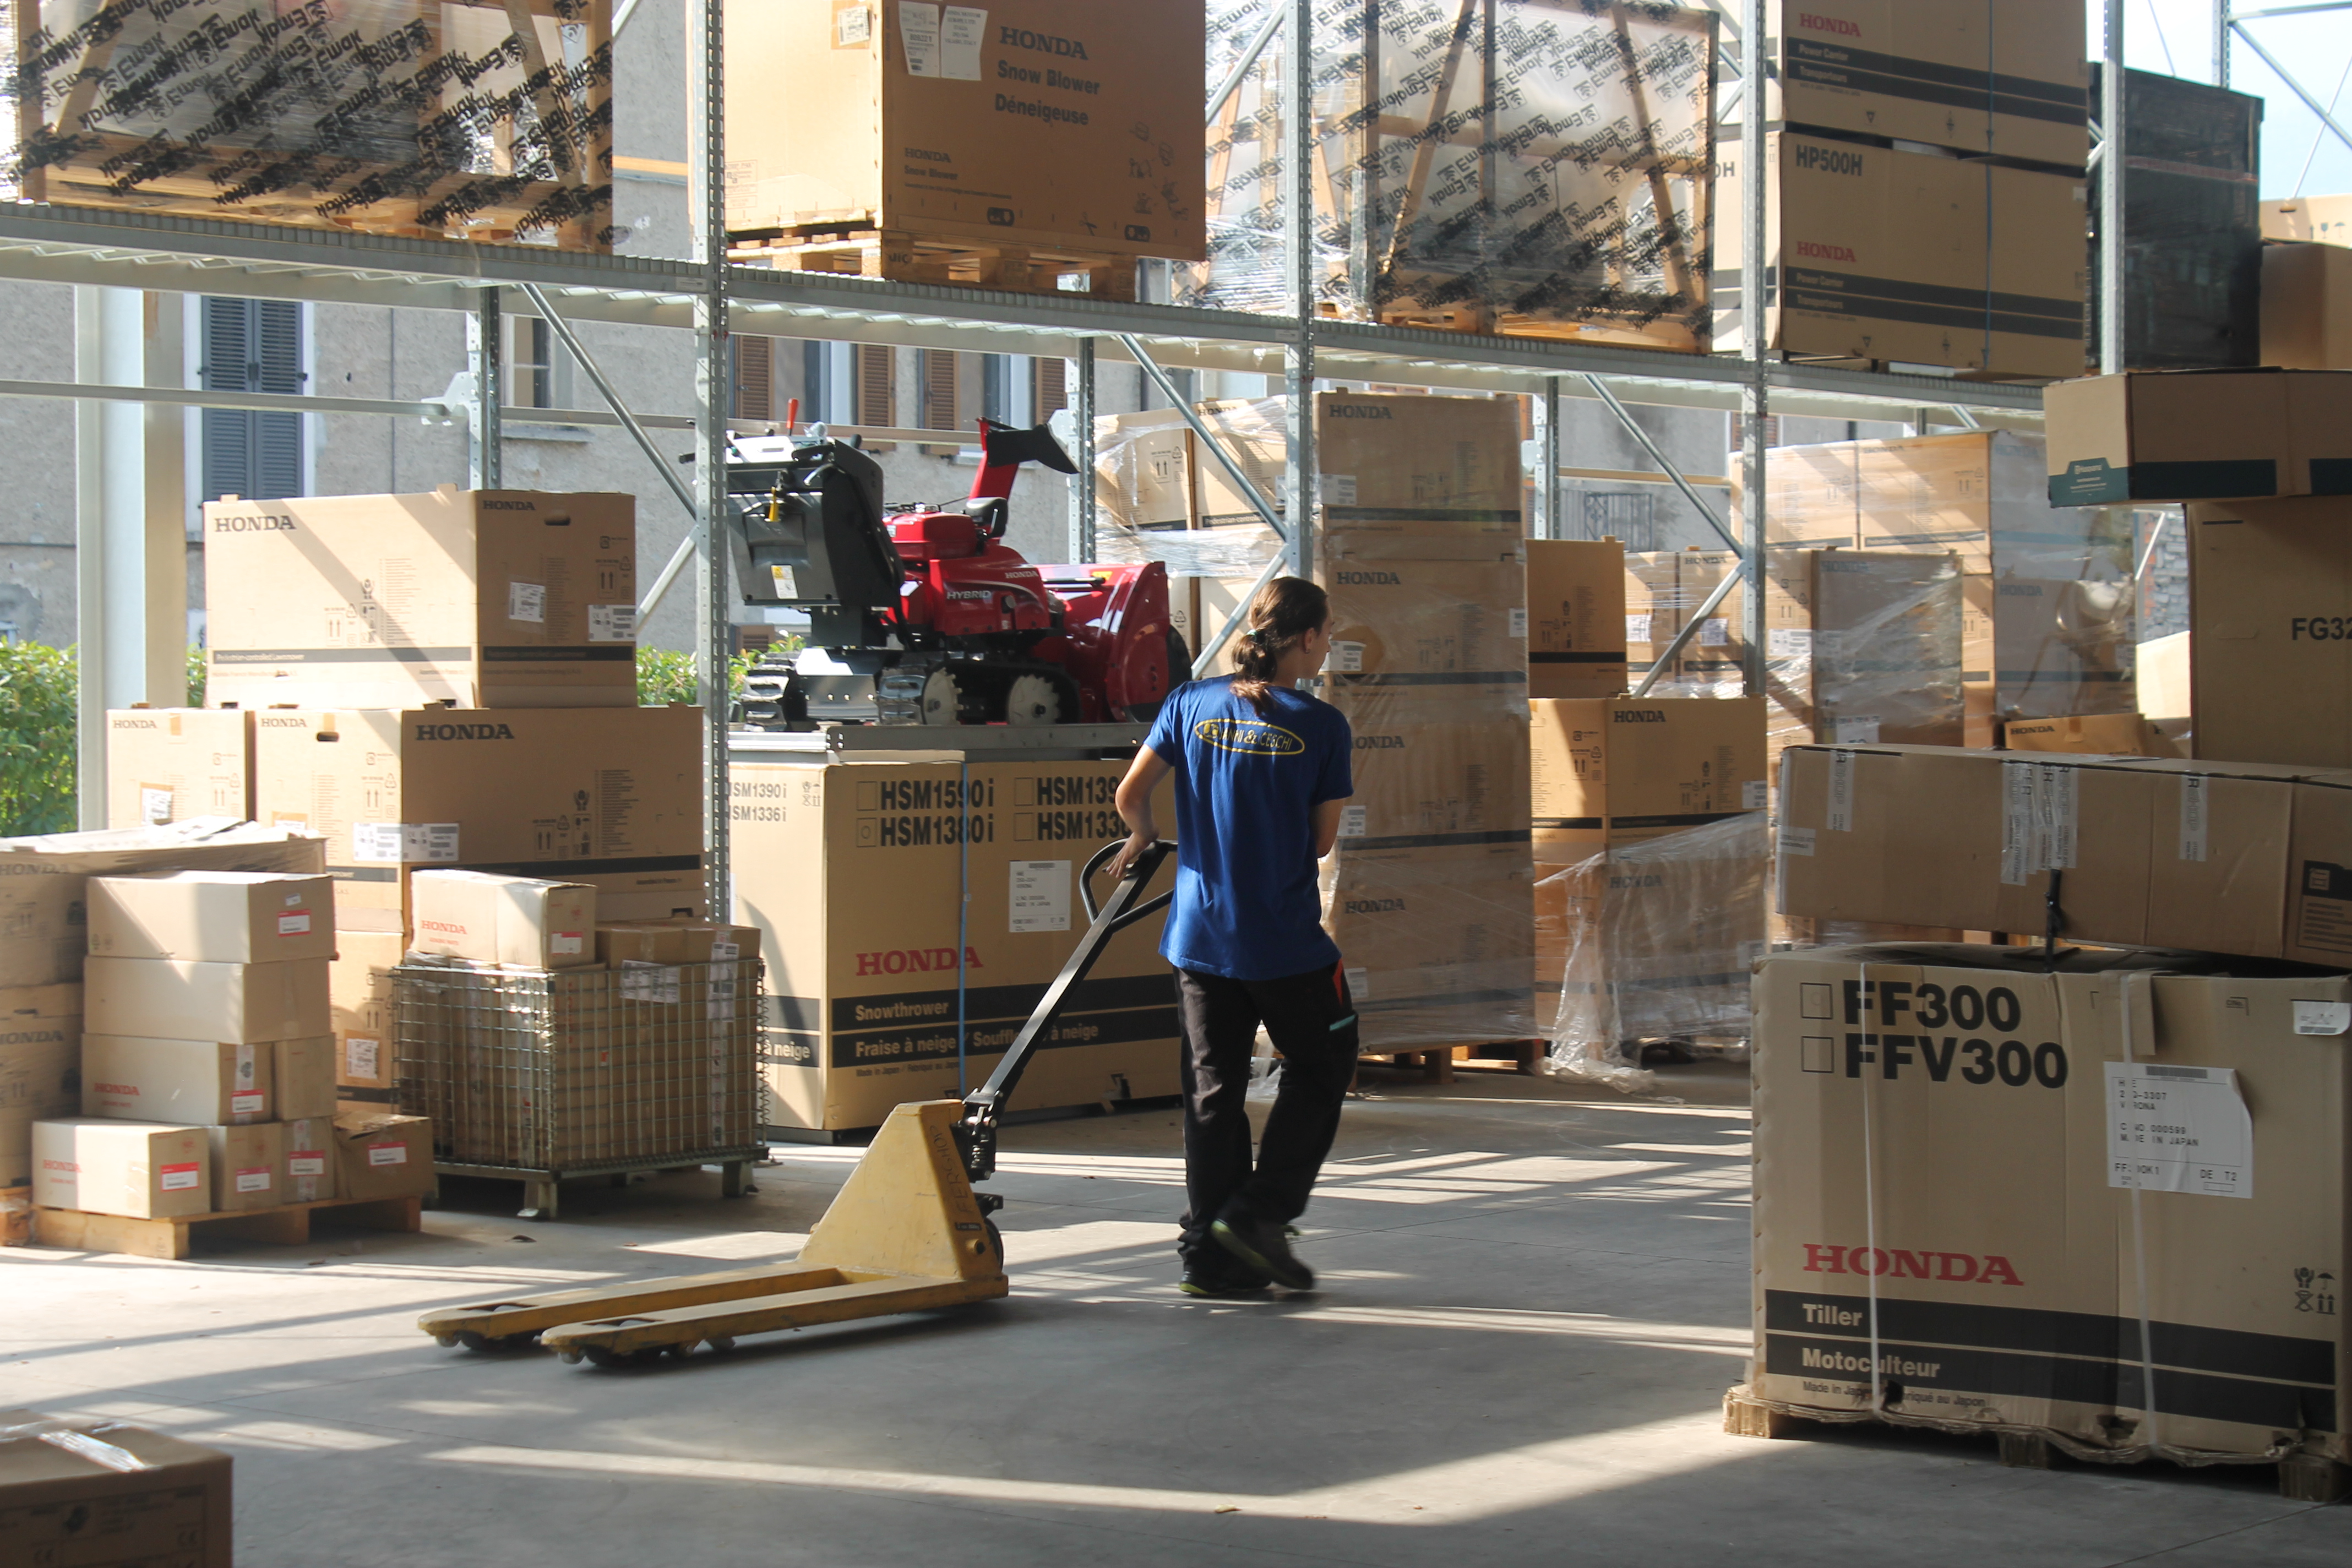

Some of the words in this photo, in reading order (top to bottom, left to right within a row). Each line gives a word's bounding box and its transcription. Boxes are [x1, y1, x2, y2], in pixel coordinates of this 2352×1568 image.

[1799, 13, 1861, 37] HONDA
[999, 26, 1088, 61] HONDA
[997, 59, 1041, 84] Snow
[1047, 68, 1100, 95] Blower
[995, 93, 1089, 125] Déneigeuse
[904, 147, 951, 164] HONDA
[1796, 144, 1863, 176] HP500H
[1796, 241, 1856, 262] HONDA
[1329, 405, 1392, 420] HONDA
[483, 500, 536, 510] HONDA
[214, 515, 296, 532] HONDA
[1684, 556, 1727, 565] HONDA
[1005, 570, 1039, 579] HONDA
[1337, 571, 1401, 586] HONDA
[947, 590, 990, 600] HYBRID
[113, 720, 157, 729] HONDA
[261, 718, 307, 728] HONDA
[1614, 710, 1666, 723] HONDA
[415, 723, 515, 741] HONDA
[2011, 726, 2055, 735] HONDA
[1260, 732, 1292, 750] CESCHI
[880, 777, 994, 810] HSM1590i
[1037, 776, 1120, 805] HSM139
[880, 813, 994, 847] HSM1380i
[1037, 810, 1133, 841] HSM133
[1344, 899, 1406, 913] HONDA
[422, 920, 467, 935] HONDA
[856, 946, 983, 976] HONDA
[856, 1001, 949, 1021] Snowthrower
[1843, 980, 2021, 1032] FF300
[856, 1039, 900, 1057] Fraise
[903, 1038, 913, 1054] à
[917, 1034, 956, 1054] neige
[973, 1028, 1022, 1047] Souffl
[1050, 1025, 1059, 1041] à
[1062, 1023, 1098, 1039] neige
[774, 1041, 810, 1061] neige
[1845, 1033, 2068, 1088] FFV300
[93, 1083, 140, 1096] HONDA
[2120, 1090, 2166, 1101] 20-3307
[2120, 1101, 2155, 1110] VRONA
[2120, 1123, 2186, 1135] CNO.000599
[2121, 1134, 2144, 1143] MDE
[2152, 1136, 2163, 1144] IN
[2169, 1137, 2199, 1146] JAPAN
[43, 1159, 82, 1173] HONDA
[2224, 1170, 2237, 1182] T2
[1803, 1244, 2024, 1286] HONDA
[1803, 1303, 1863, 1326] Tiller
[1803, 1347, 1941, 1378] Motoculteur
[1803, 1381, 1829, 1392] Made
[1832, 1382, 1841, 1393] in
[1904, 1391, 1933, 1403] riqué
[1937, 1395, 1950, 1404] au
[1953, 1395, 1985, 1408] Japon
